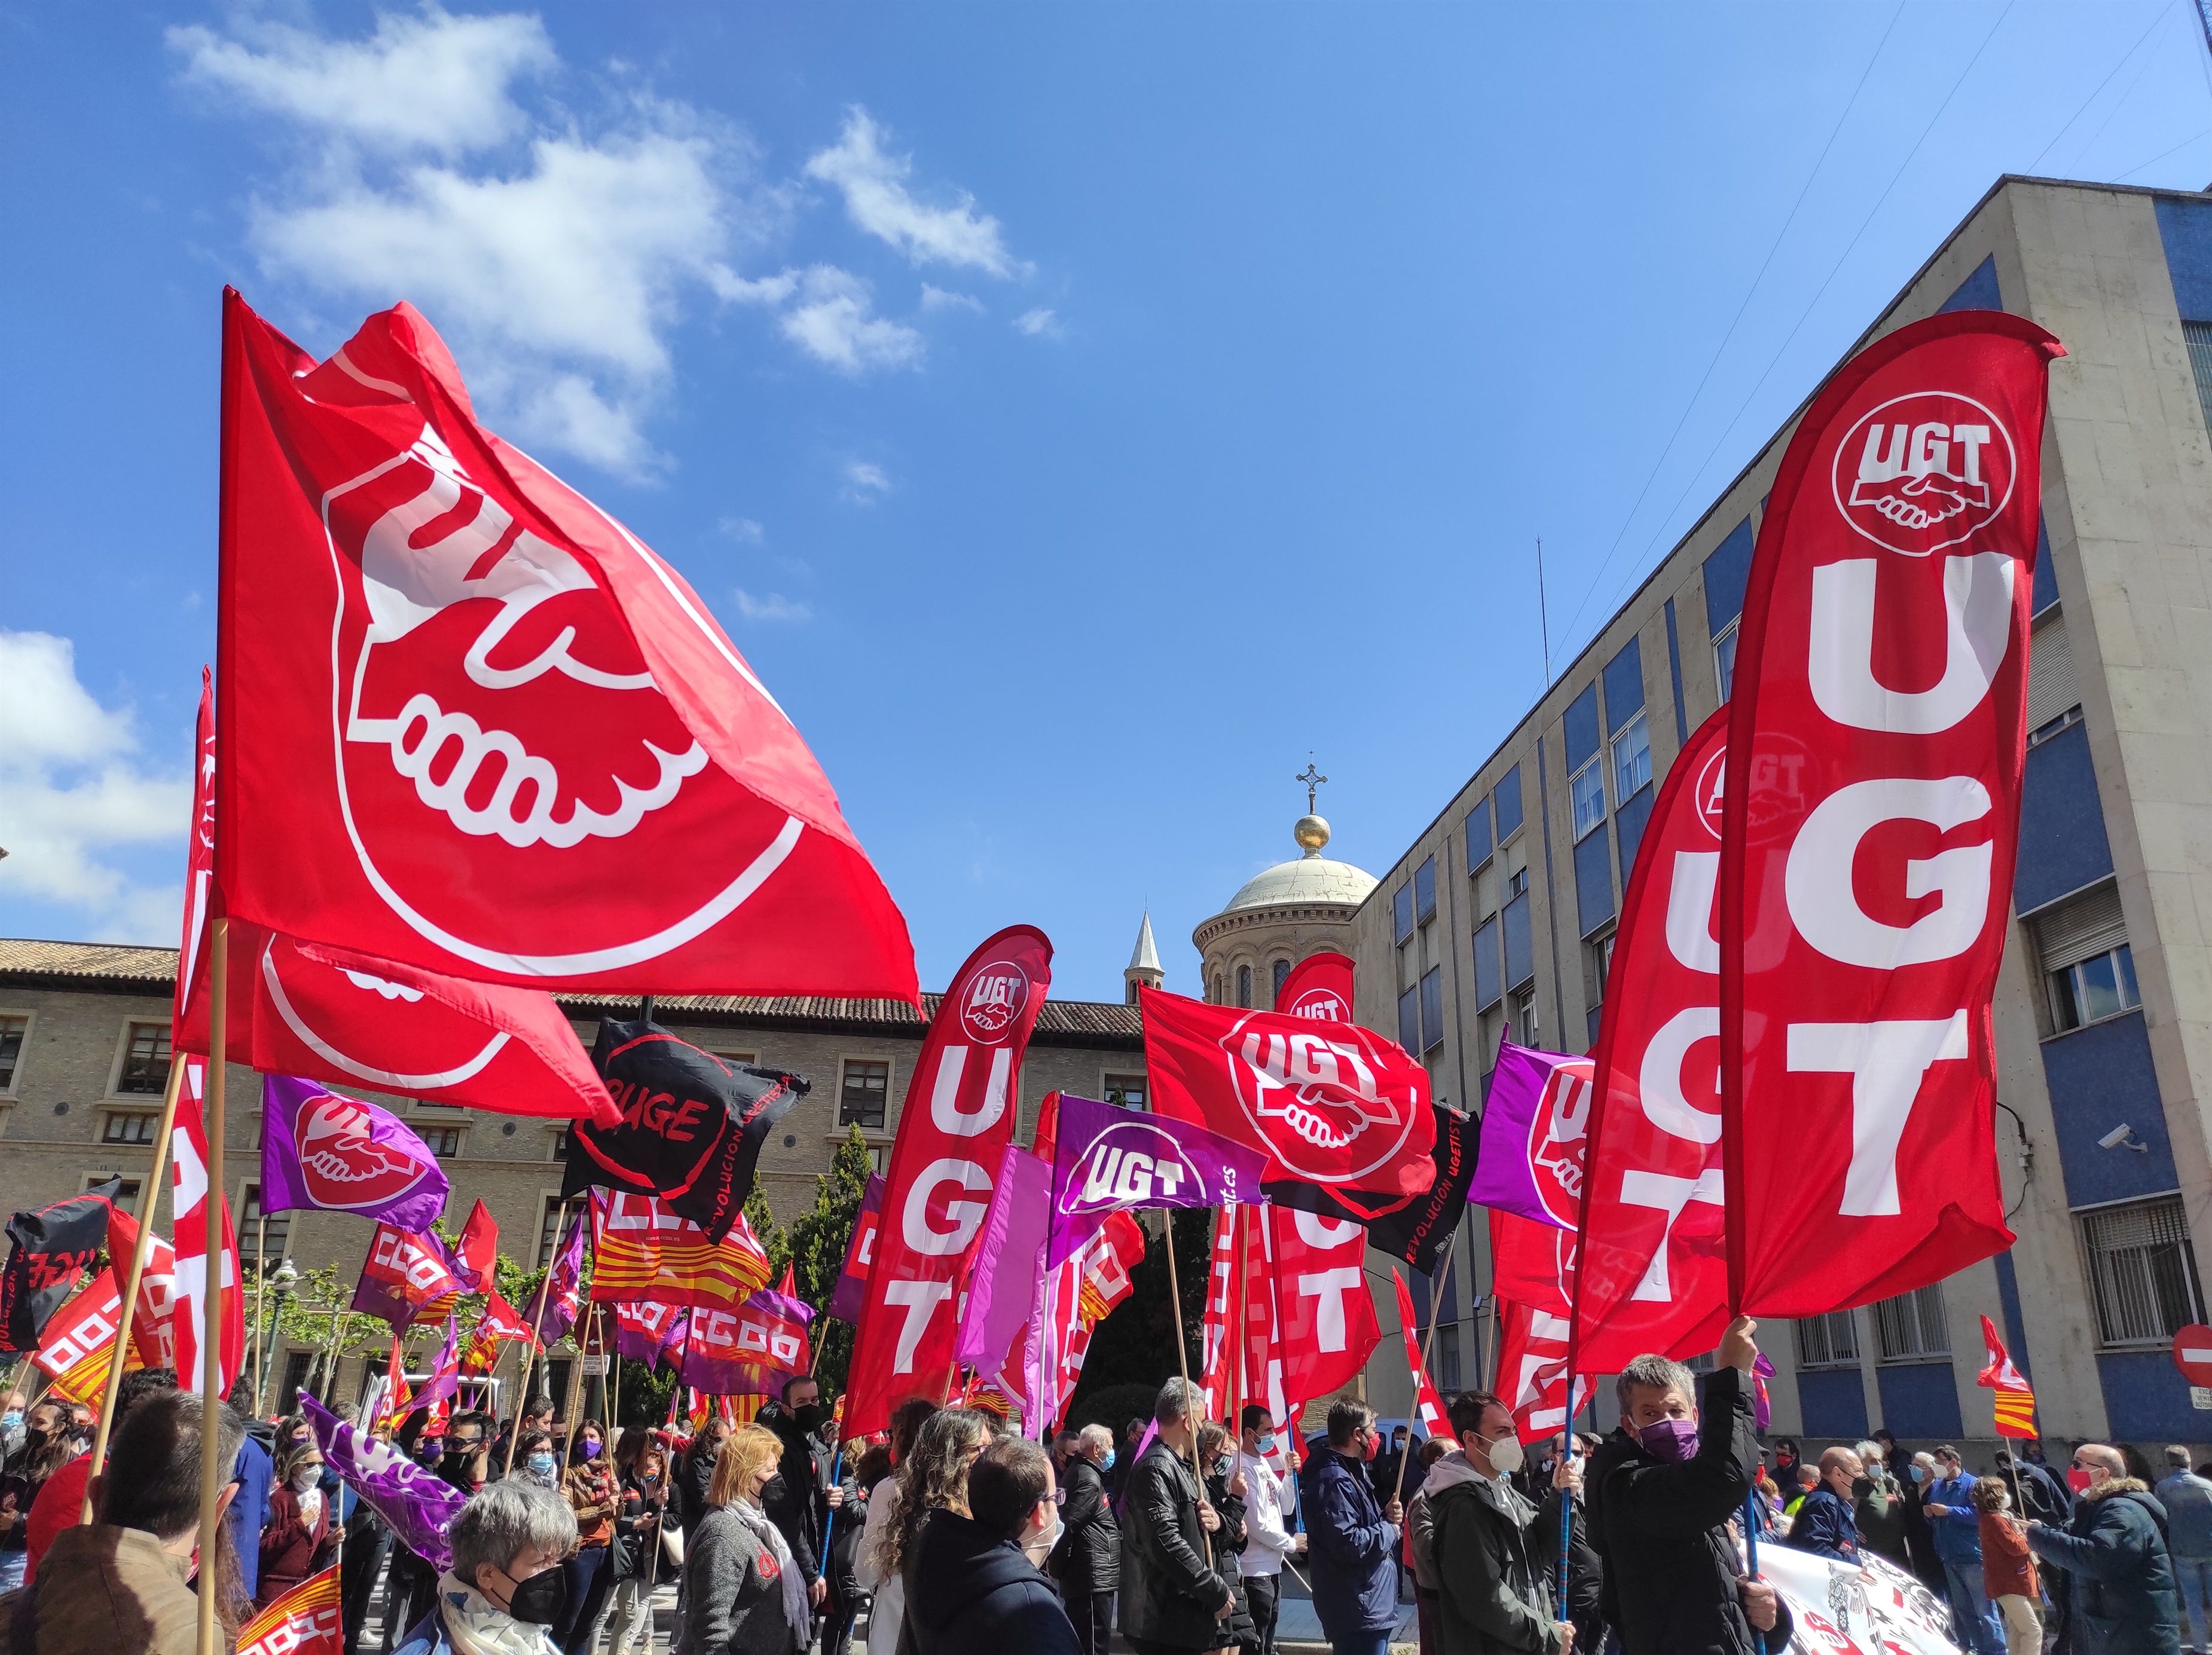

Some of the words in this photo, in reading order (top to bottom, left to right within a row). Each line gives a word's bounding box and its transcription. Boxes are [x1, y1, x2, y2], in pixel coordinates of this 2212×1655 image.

[1857, 421, 1990, 486] UGT
[1785, 552, 2014, 1216] UGT
[971, 976, 1022, 1007] UGT
[1296, 999, 1339, 1022] UGT
[1242, 1032, 1377, 1102] UGT
[1083, 1144, 1185, 1202] UGT
[1406, 1179, 1454, 1264] REVOLUCIÓN
[1448, 1116, 1463, 1177] UGETIST
[884, 1045, 1013, 1375] UGT
[691, 1307, 801, 1368] CCOO
